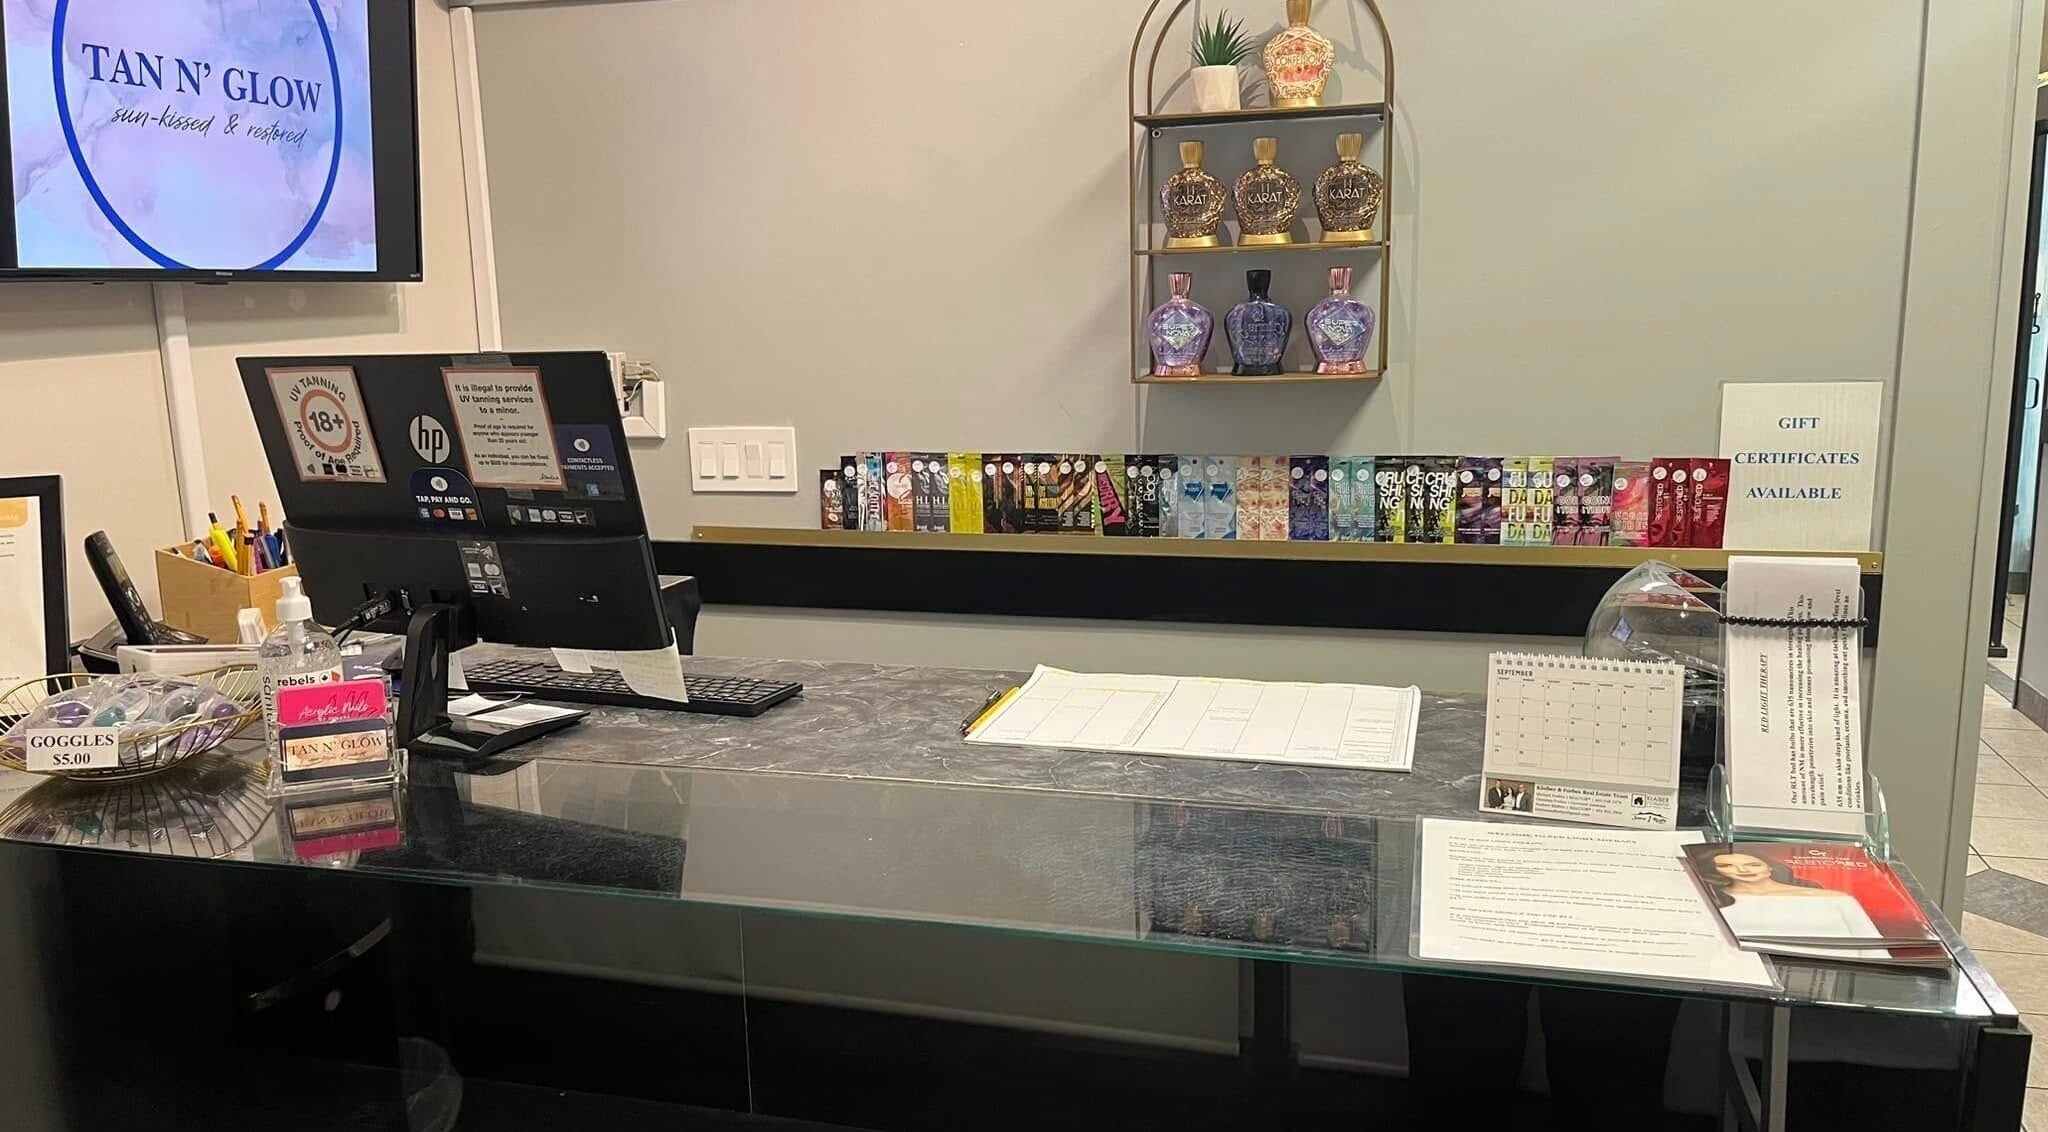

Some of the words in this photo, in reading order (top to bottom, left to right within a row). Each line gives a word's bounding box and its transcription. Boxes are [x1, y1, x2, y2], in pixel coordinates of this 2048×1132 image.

[81, 43, 164, 91] TAN
[174, 58, 211, 96] N'
[223, 67, 322, 113] GLOW
[111, 104, 215, 138] sun-kissed
[223, 113, 239, 135] &
[246, 120, 308, 146] restored
[1250, 192, 1282, 203] KARAT
[1329, 188, 1365, 198] KARAT
[1174, 194, 1207, 206] KARAT
[289, 384, 302, 402] UV
[299, 375, 346, 403] TANNING
[471, 384, 493, 393] illegal
[504, 384, 533, 393] provide
[472, 396, 501, 404] tanning
[308, 410, 345, 432] 18+
[1778, 417, 1820, 430] GIFT
[418, 414, 443, 463] hp
[1734, 452, 1860, 464] CERTIFICATES
[430, 495, 443, 503] PAY
[444, 496, 459, 504] AND
[1745, 487, 1842, 499] AVAILABLE
[1380, 496, 1401, 510] NG
[1429, 497, 1450, 510] NG
[1509, 506, 1526, 522] FU
[1534, 506, 1551, 523] FU
[1497, 668, 1533, 677] SEPTEMBER
[1759, 652, 1769, 691] THERAPY
[277, 675, 315, 686] rebels
[1760, 691, 1769, 716] LIGHT
[1760, 717, 1769, 733] RED
[30, 734, 114, 748] GOGGLES
[288, 743, 318, 756] TAN
[341, 736, 383, 750] GLOW
[53, 752, 91, 766] $5.00
[1799, 759, 1805, 772] NM
[1799, 772, 1805, 780] of
